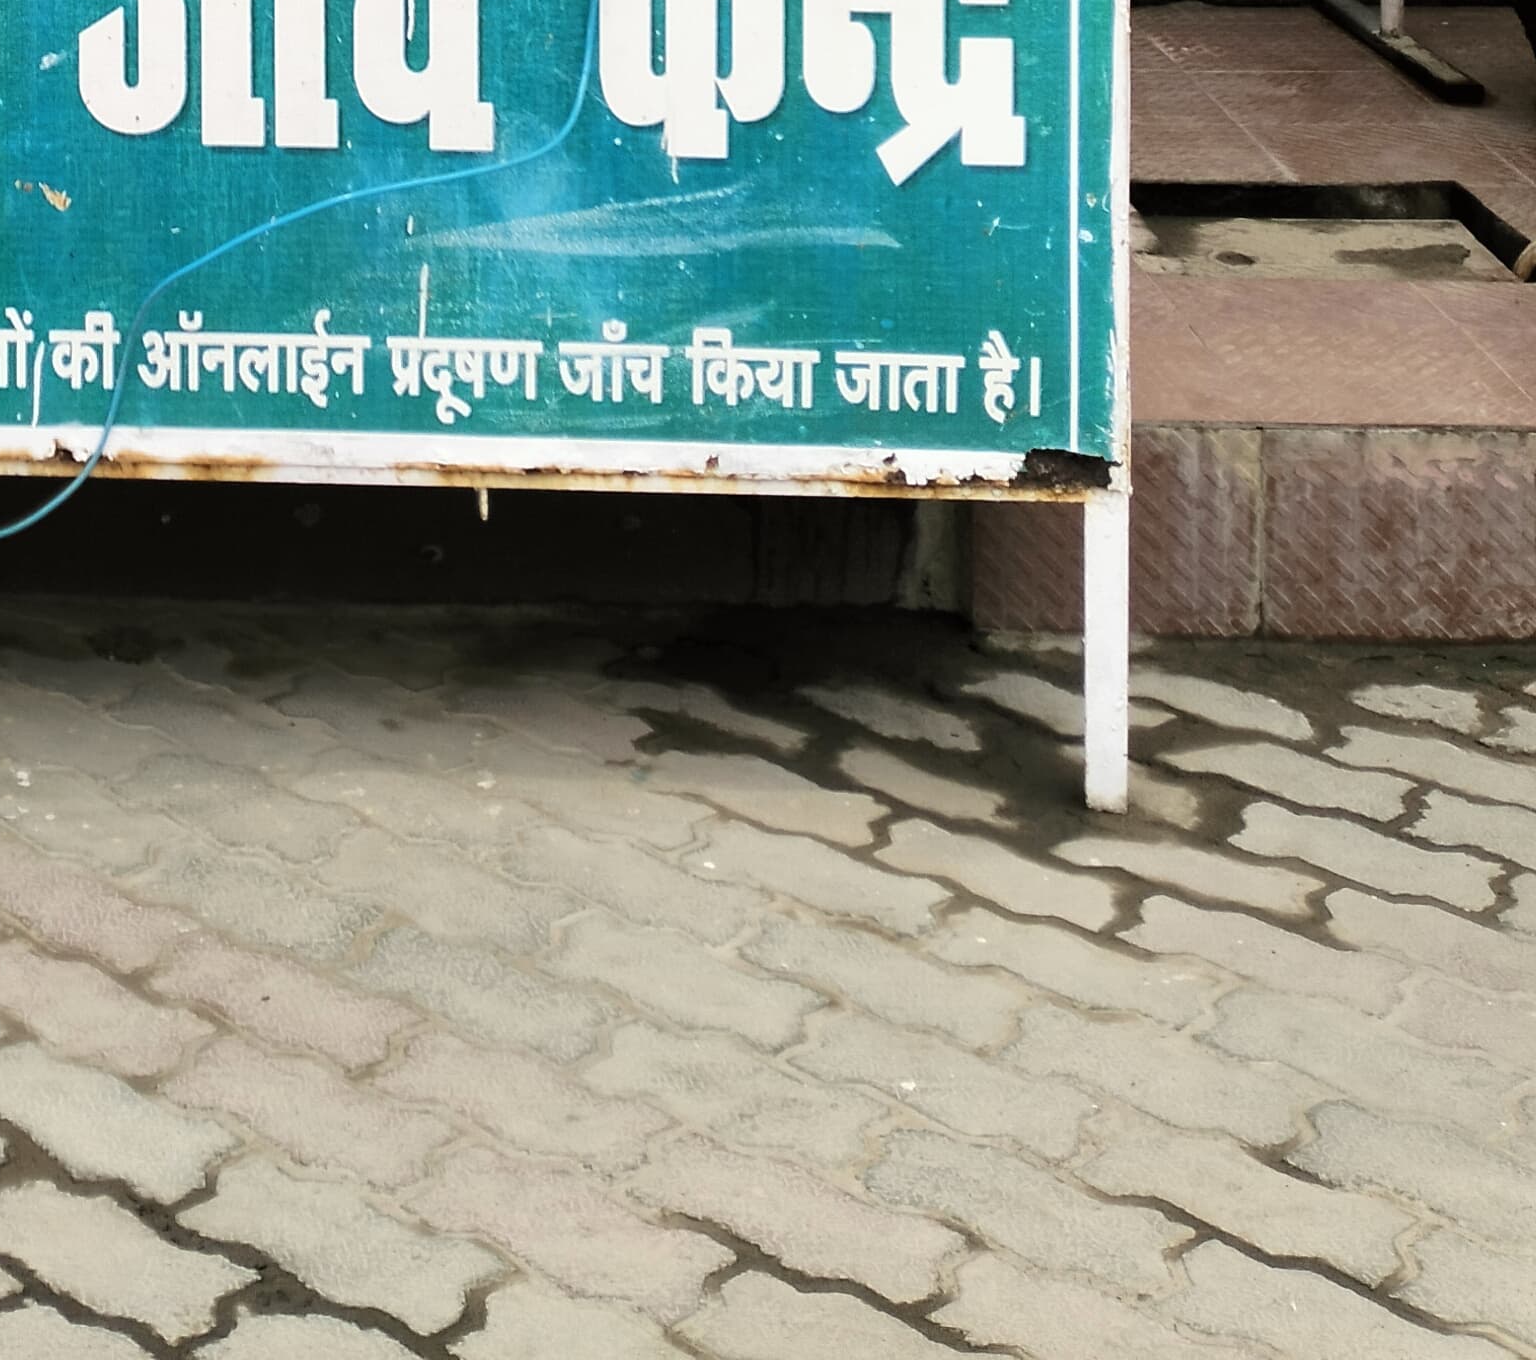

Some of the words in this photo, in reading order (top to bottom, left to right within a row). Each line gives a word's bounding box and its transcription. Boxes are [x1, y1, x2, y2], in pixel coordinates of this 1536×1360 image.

[49, 311, 120, 391] की
[138, 309, 371, 408] ऑनलाईन
[387, 335, 544, 425] प्रदूषण
[559, 319, 668, 406] जाँच
[686, 327, 821, 409] किया
[835, 343, 967, 415] जाता
